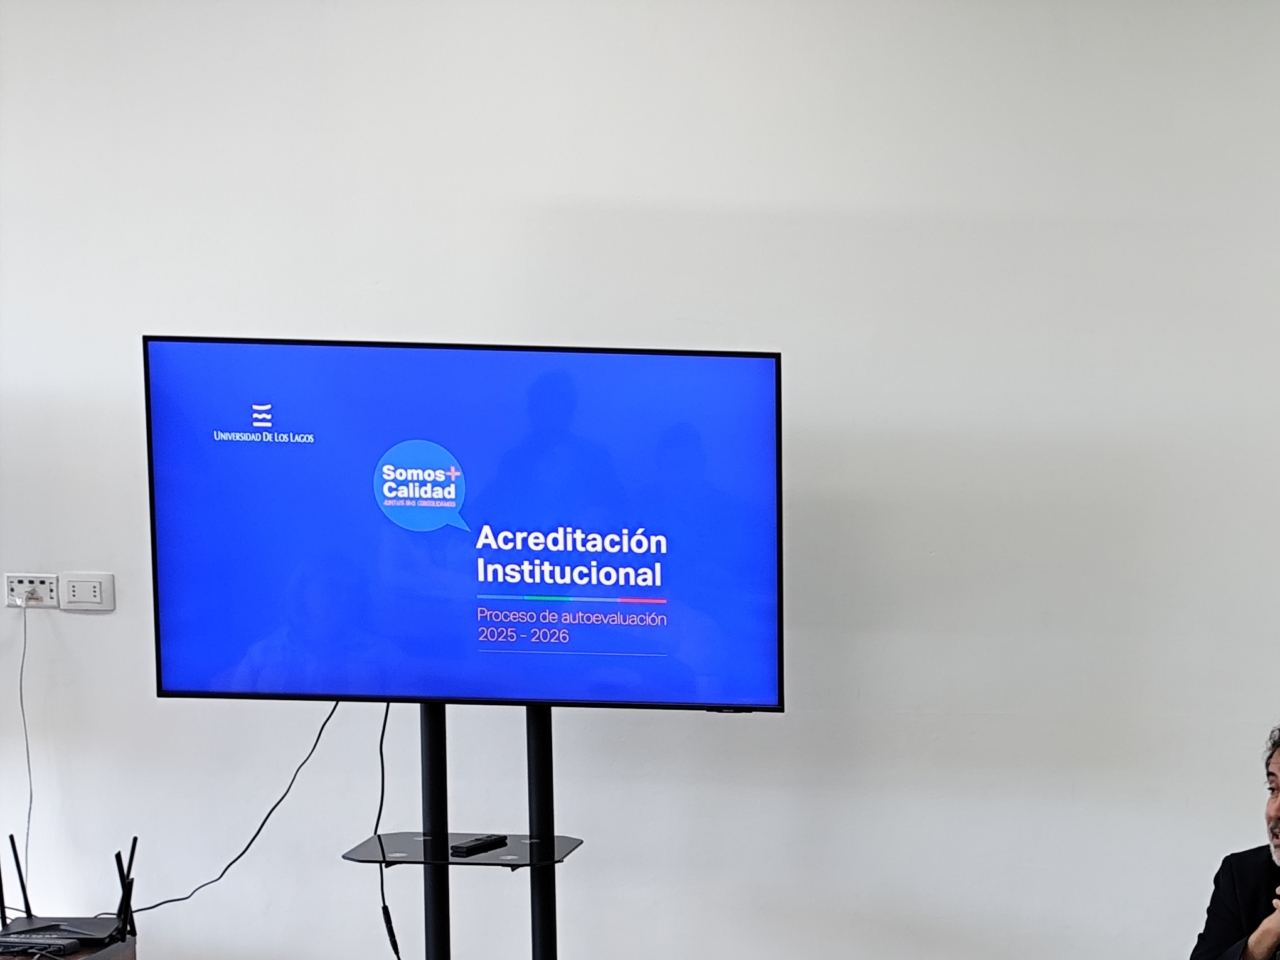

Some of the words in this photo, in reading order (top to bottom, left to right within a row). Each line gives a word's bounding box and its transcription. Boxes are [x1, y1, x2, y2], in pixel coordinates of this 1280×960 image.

[382, 481, 456, 499] Calidad
[475, 525, 667, 554] Acreditación
[477, 557, 662, 587] Institucional
[477, 607, 537, 624] Proceso
[539, 609, 558, 624] de
[561, 610, 667, 627] autoevaluación
[478, 627, 517, 642] 2025
[530, 628, 570, 643] 2026
